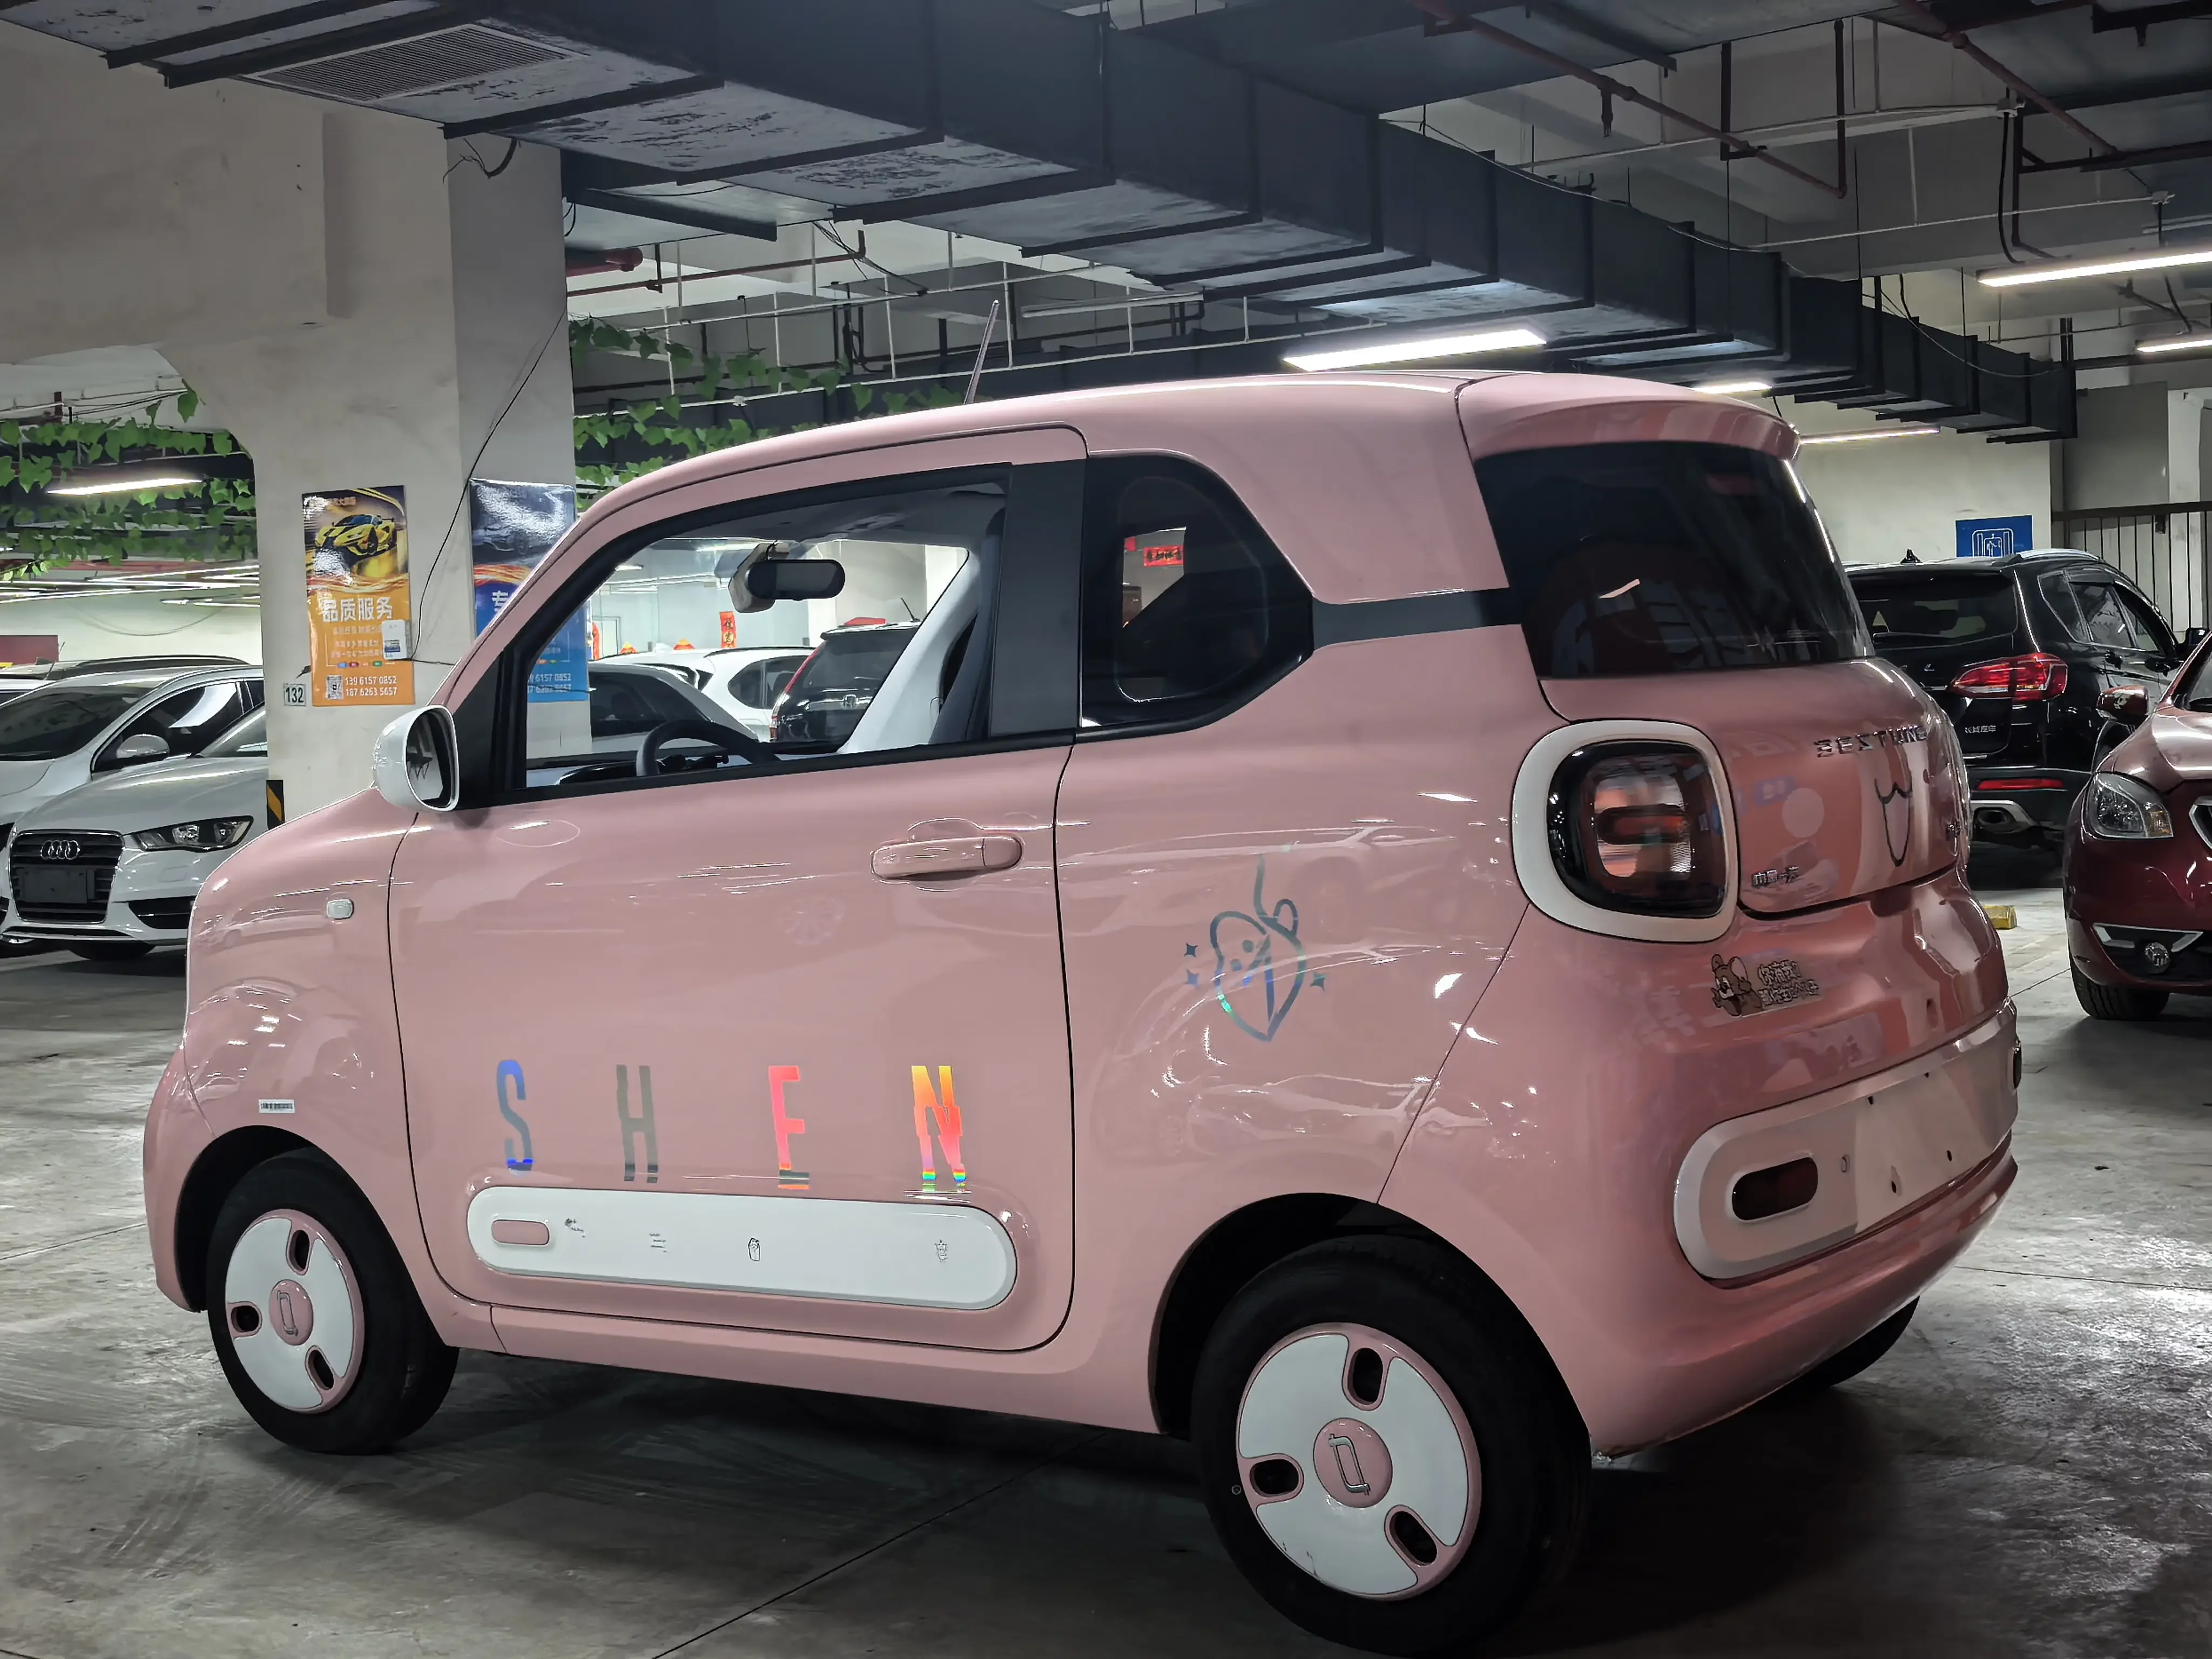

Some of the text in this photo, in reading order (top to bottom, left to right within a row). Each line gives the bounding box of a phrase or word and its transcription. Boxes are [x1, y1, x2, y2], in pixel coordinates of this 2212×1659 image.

[323, 596, 393, 622] 品质服务
[286, 686, 304, 703] 132
